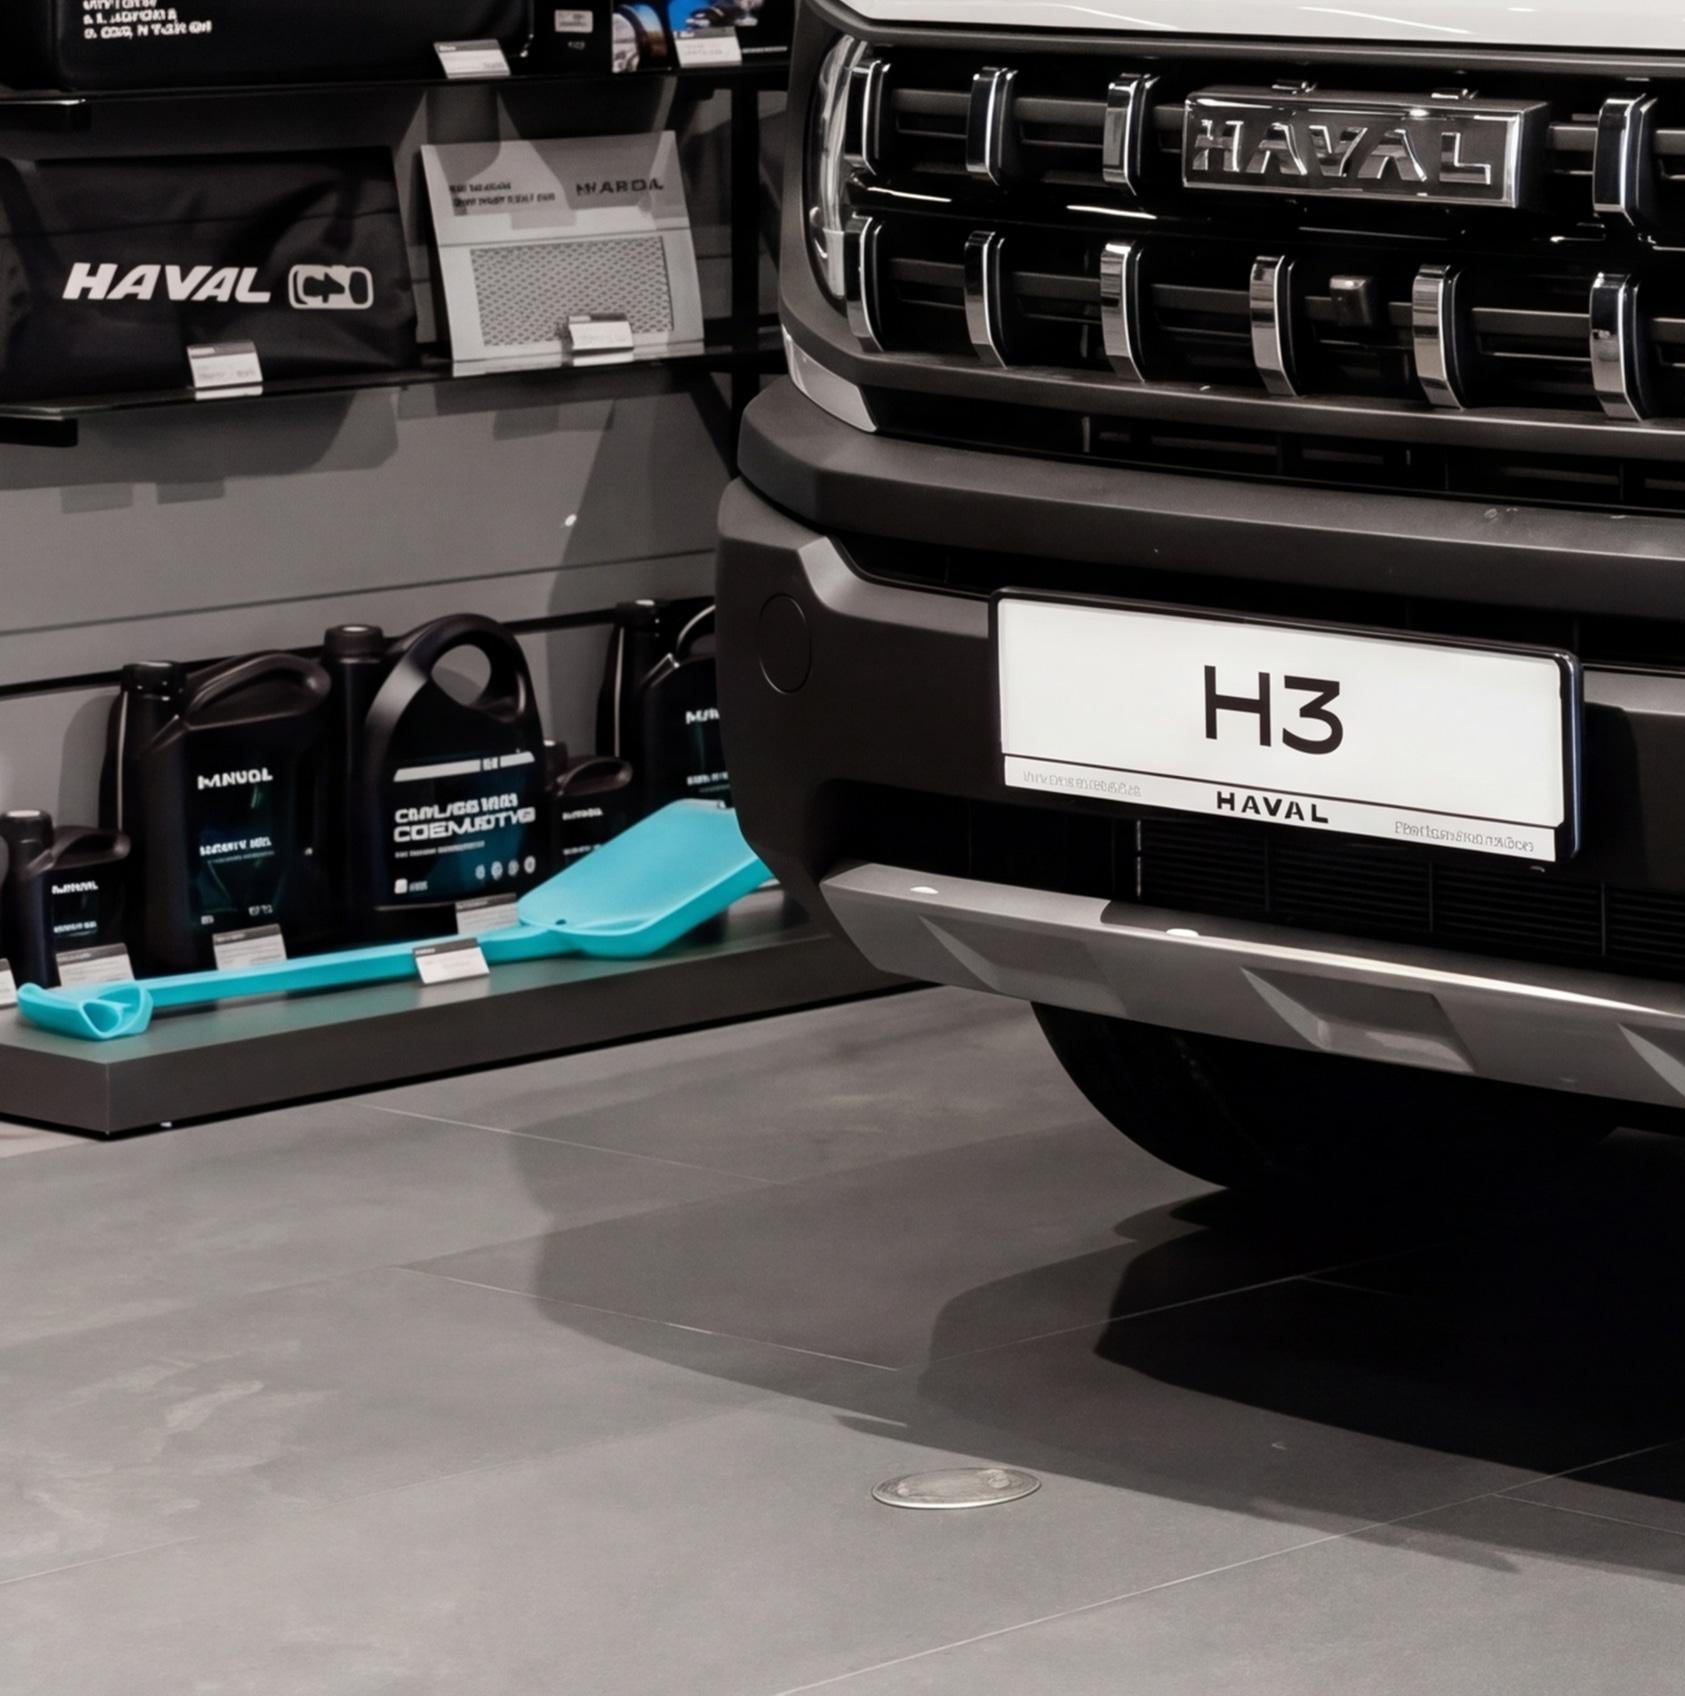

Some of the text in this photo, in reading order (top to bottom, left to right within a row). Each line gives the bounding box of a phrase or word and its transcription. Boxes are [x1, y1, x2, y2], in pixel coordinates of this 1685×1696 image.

[1193, 118, 1493, 185] HAVAL
[62, 262, 272, 303] HAVAL
[1203, 664, 1344, 756] H3
[1215, 790, 1329, 825] HAVAL
